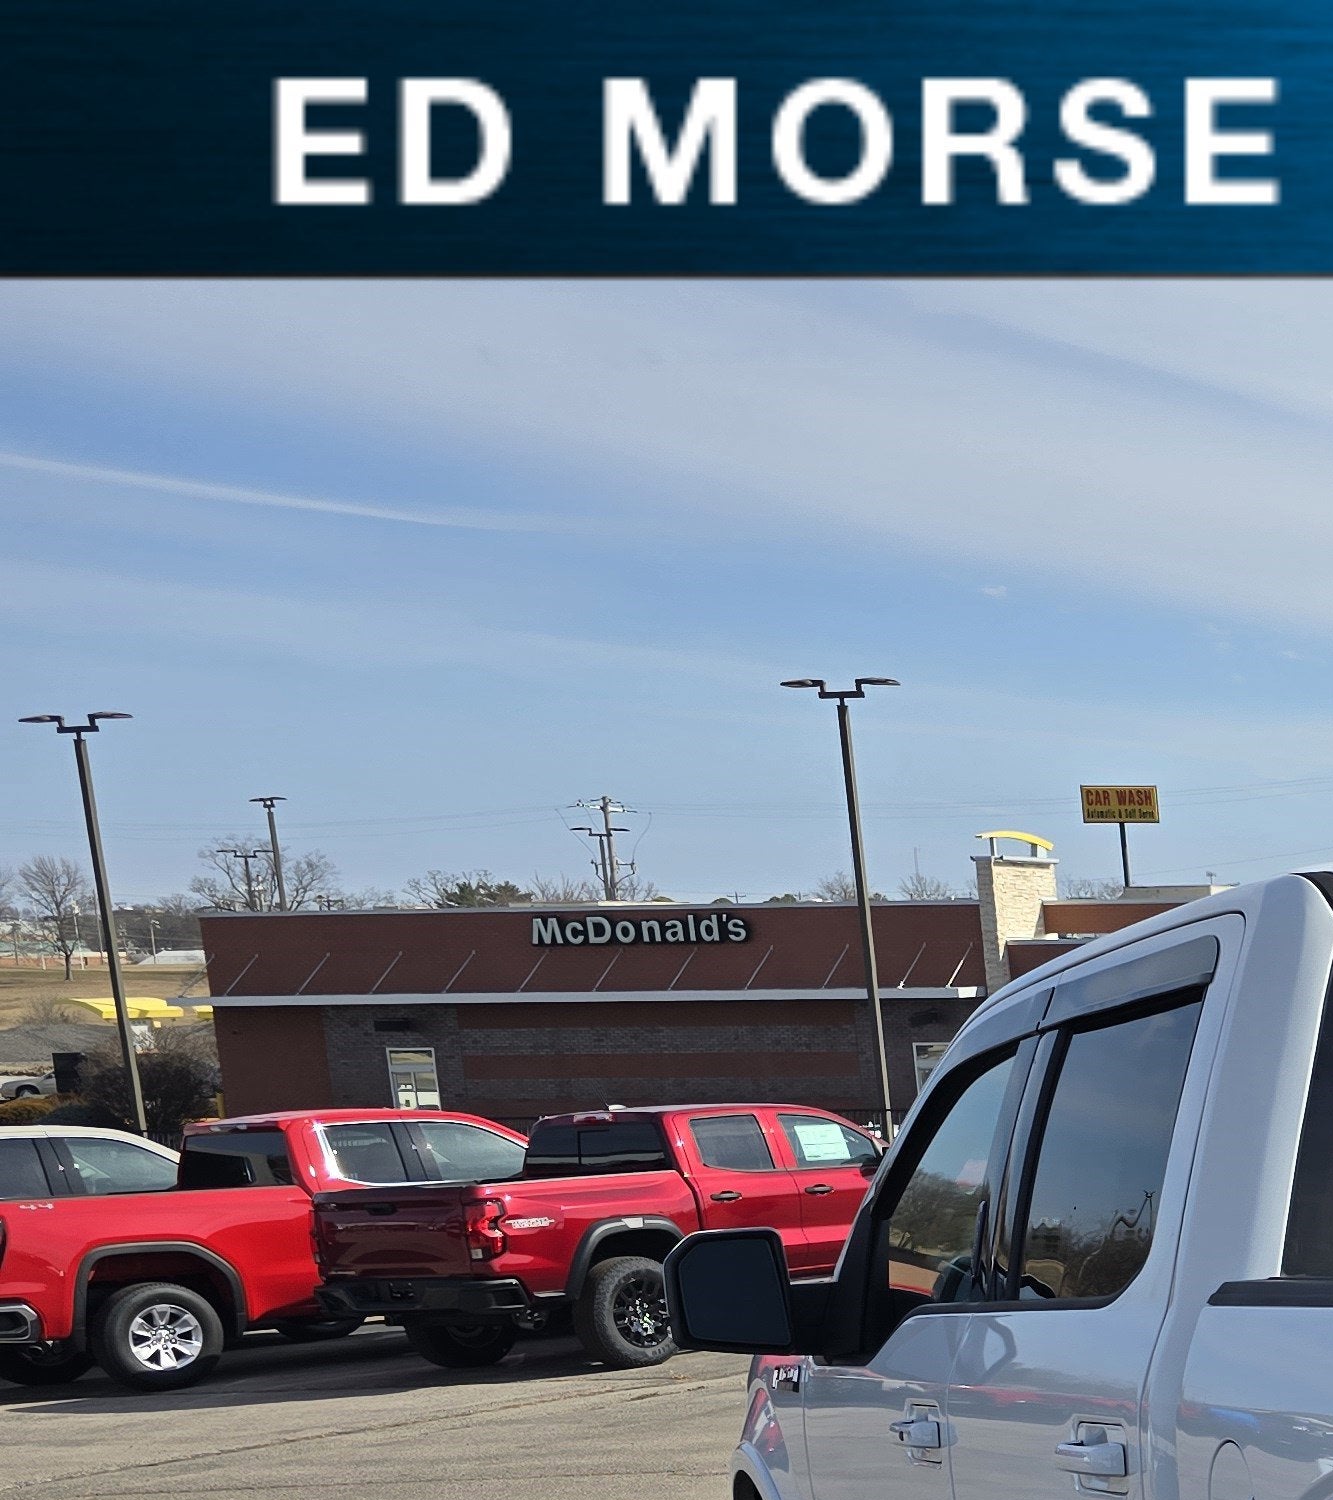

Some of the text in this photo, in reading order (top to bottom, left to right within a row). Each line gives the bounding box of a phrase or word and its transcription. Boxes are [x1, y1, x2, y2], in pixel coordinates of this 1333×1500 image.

[1085, 789, 1153, 806] CAR WASH
[531, 913, 748, 945] McDonald's
